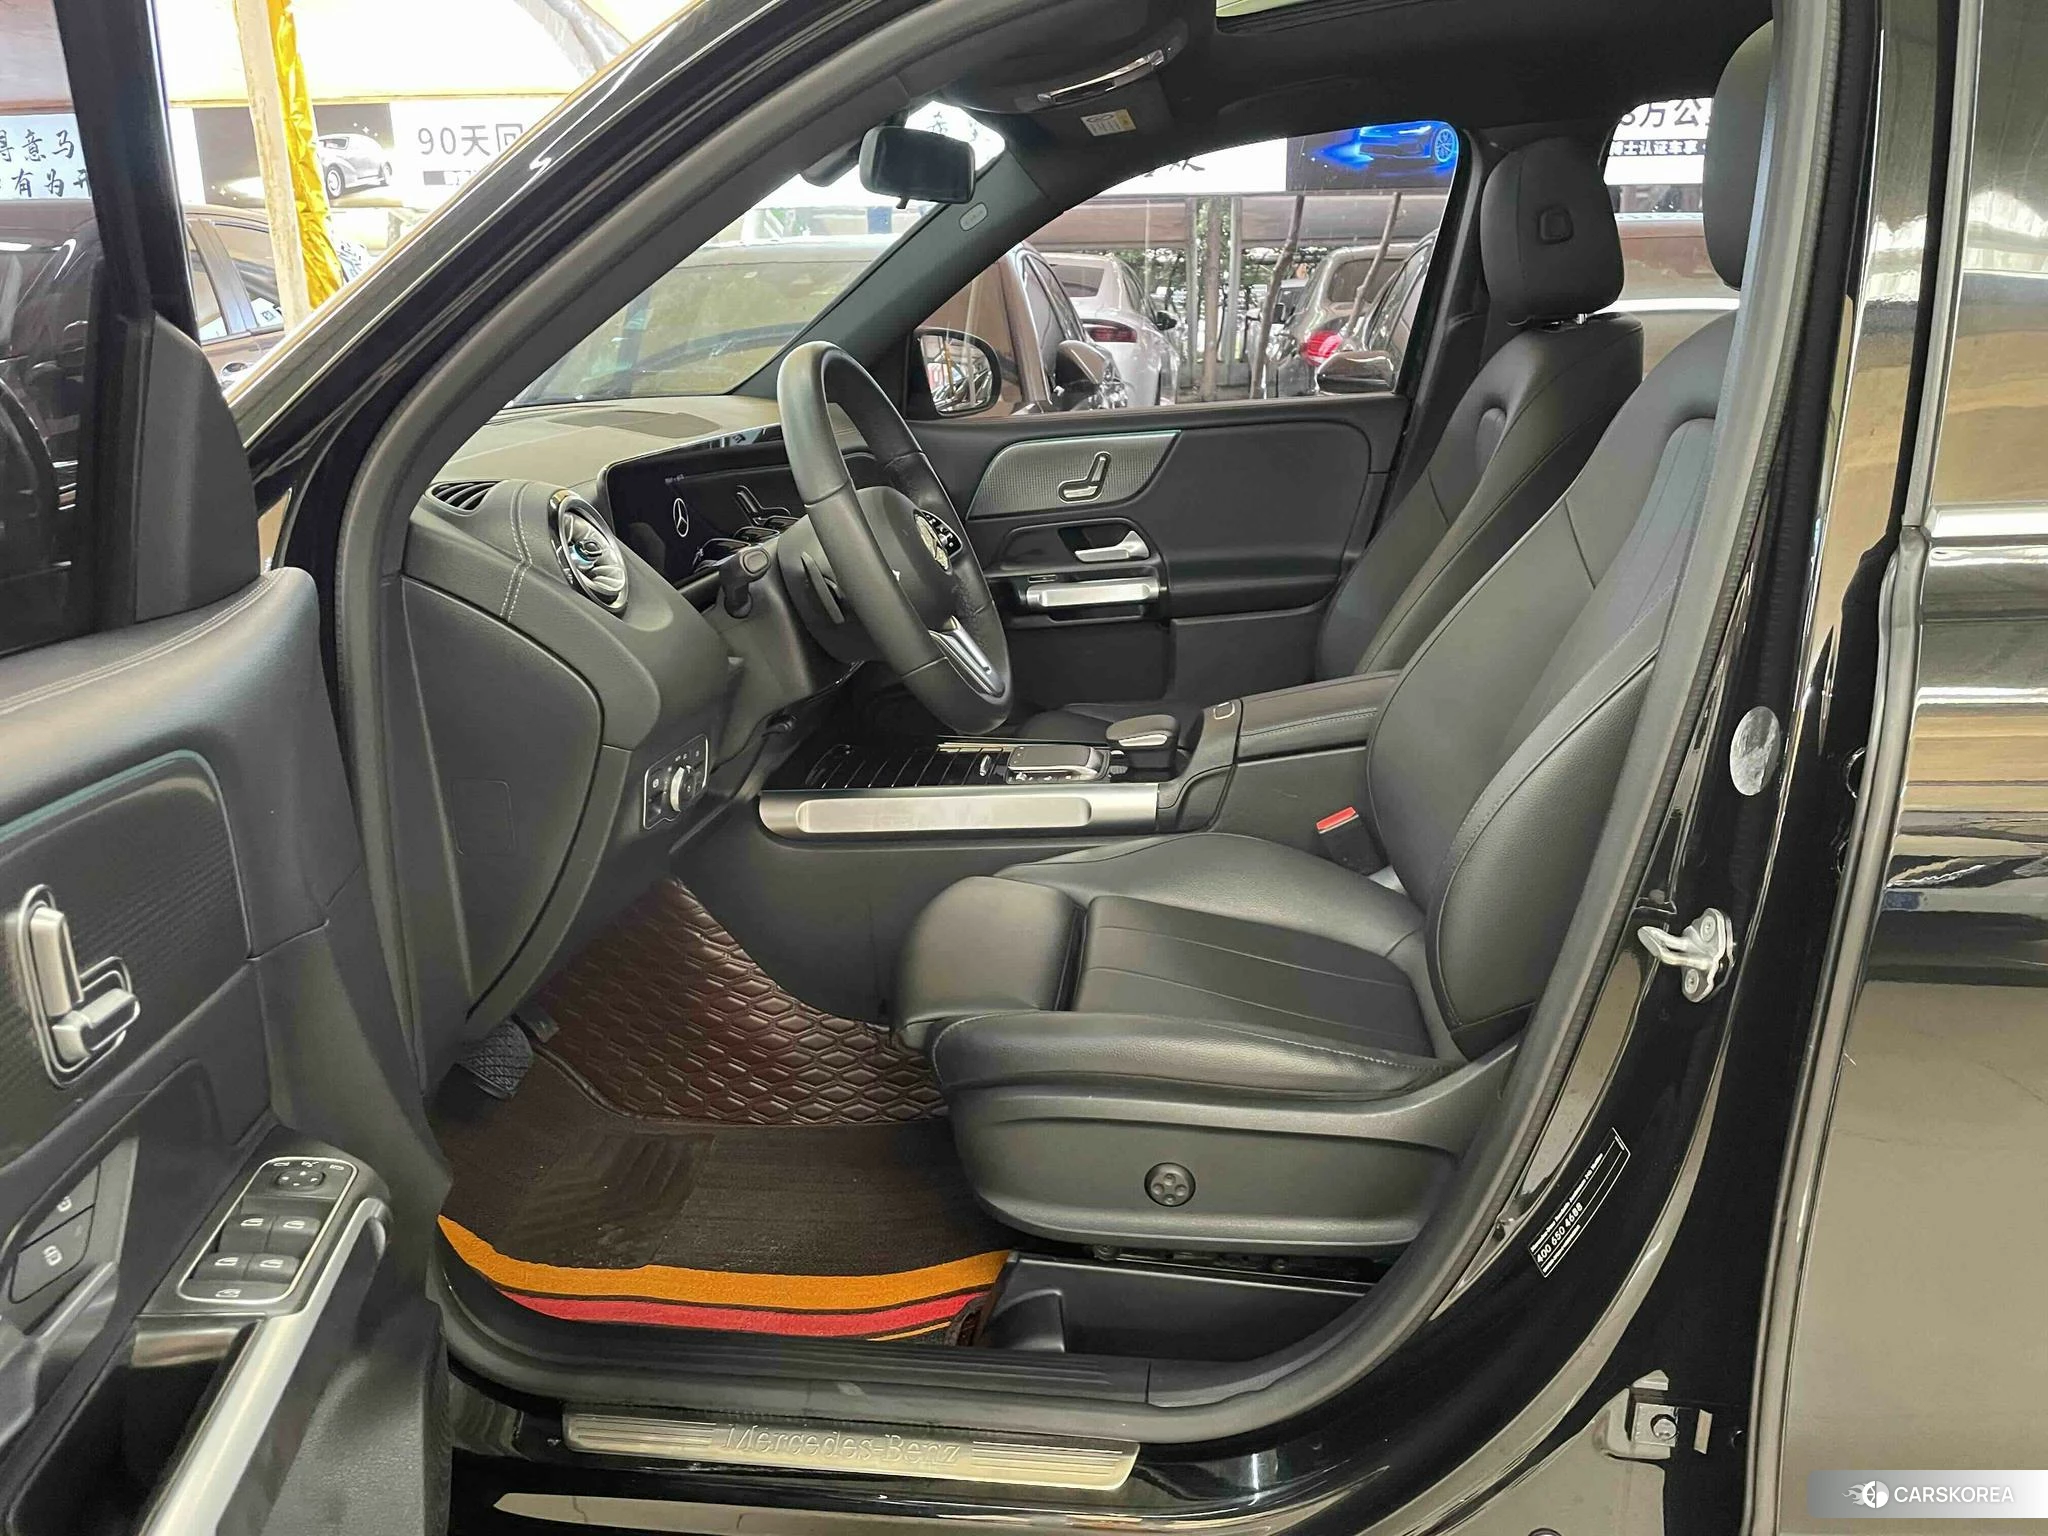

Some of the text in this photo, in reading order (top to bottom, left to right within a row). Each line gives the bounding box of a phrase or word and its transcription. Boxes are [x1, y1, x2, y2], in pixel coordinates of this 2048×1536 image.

[0, 168, 92, 198] 有为开
[1537, 1243, 1552, 1263] 400
[1551, 1225, 1566, 1246] 650
[722, 1423, 961, 1466] Mercedes-Benz
